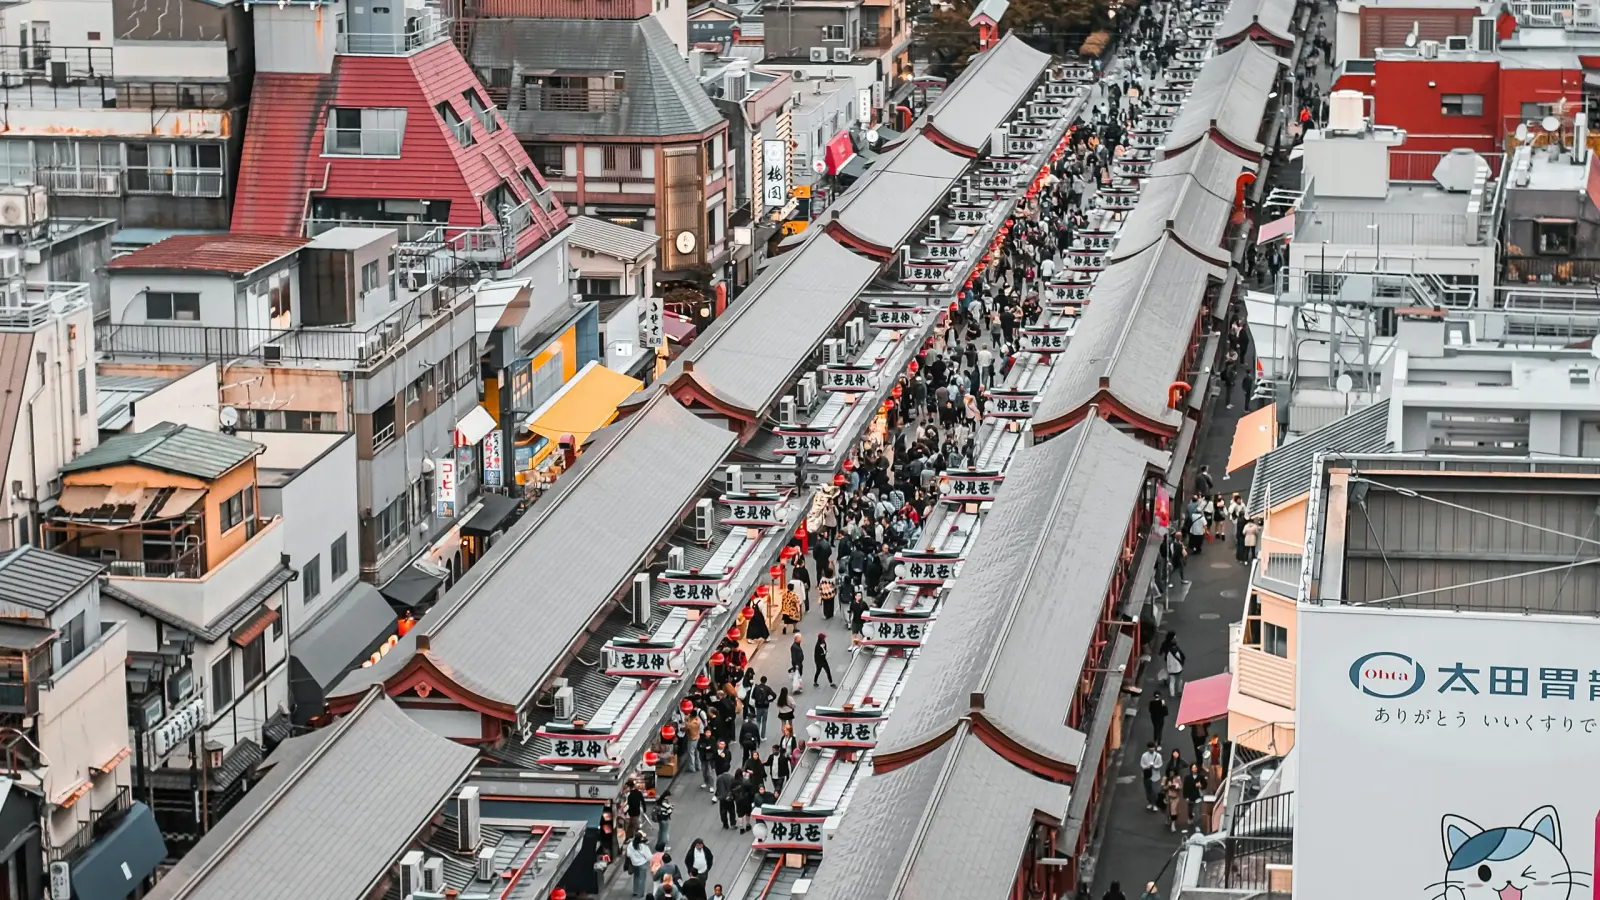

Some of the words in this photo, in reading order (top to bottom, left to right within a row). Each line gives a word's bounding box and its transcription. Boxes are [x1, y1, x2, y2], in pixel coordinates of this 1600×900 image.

[997, 399, 1030, 412] 仲見世
[442, 464, 452, 496] コーヒー
[954, 480, 990, 494] 仲見世
[910, 563, 950, 578] 仲見世
[878, 622, 920, 639] 仲見世
[1364, 668, 1408, 681] Ohta
[1437, 662, 1600, 701] 太田胃
[1375, 707, 1467, 728] ありがとう
[1484, 714, 1597, 733] いいくすりで
[825, 722, 870, 740] 仲見世
[771, 823, 820, 842] 仲見世
